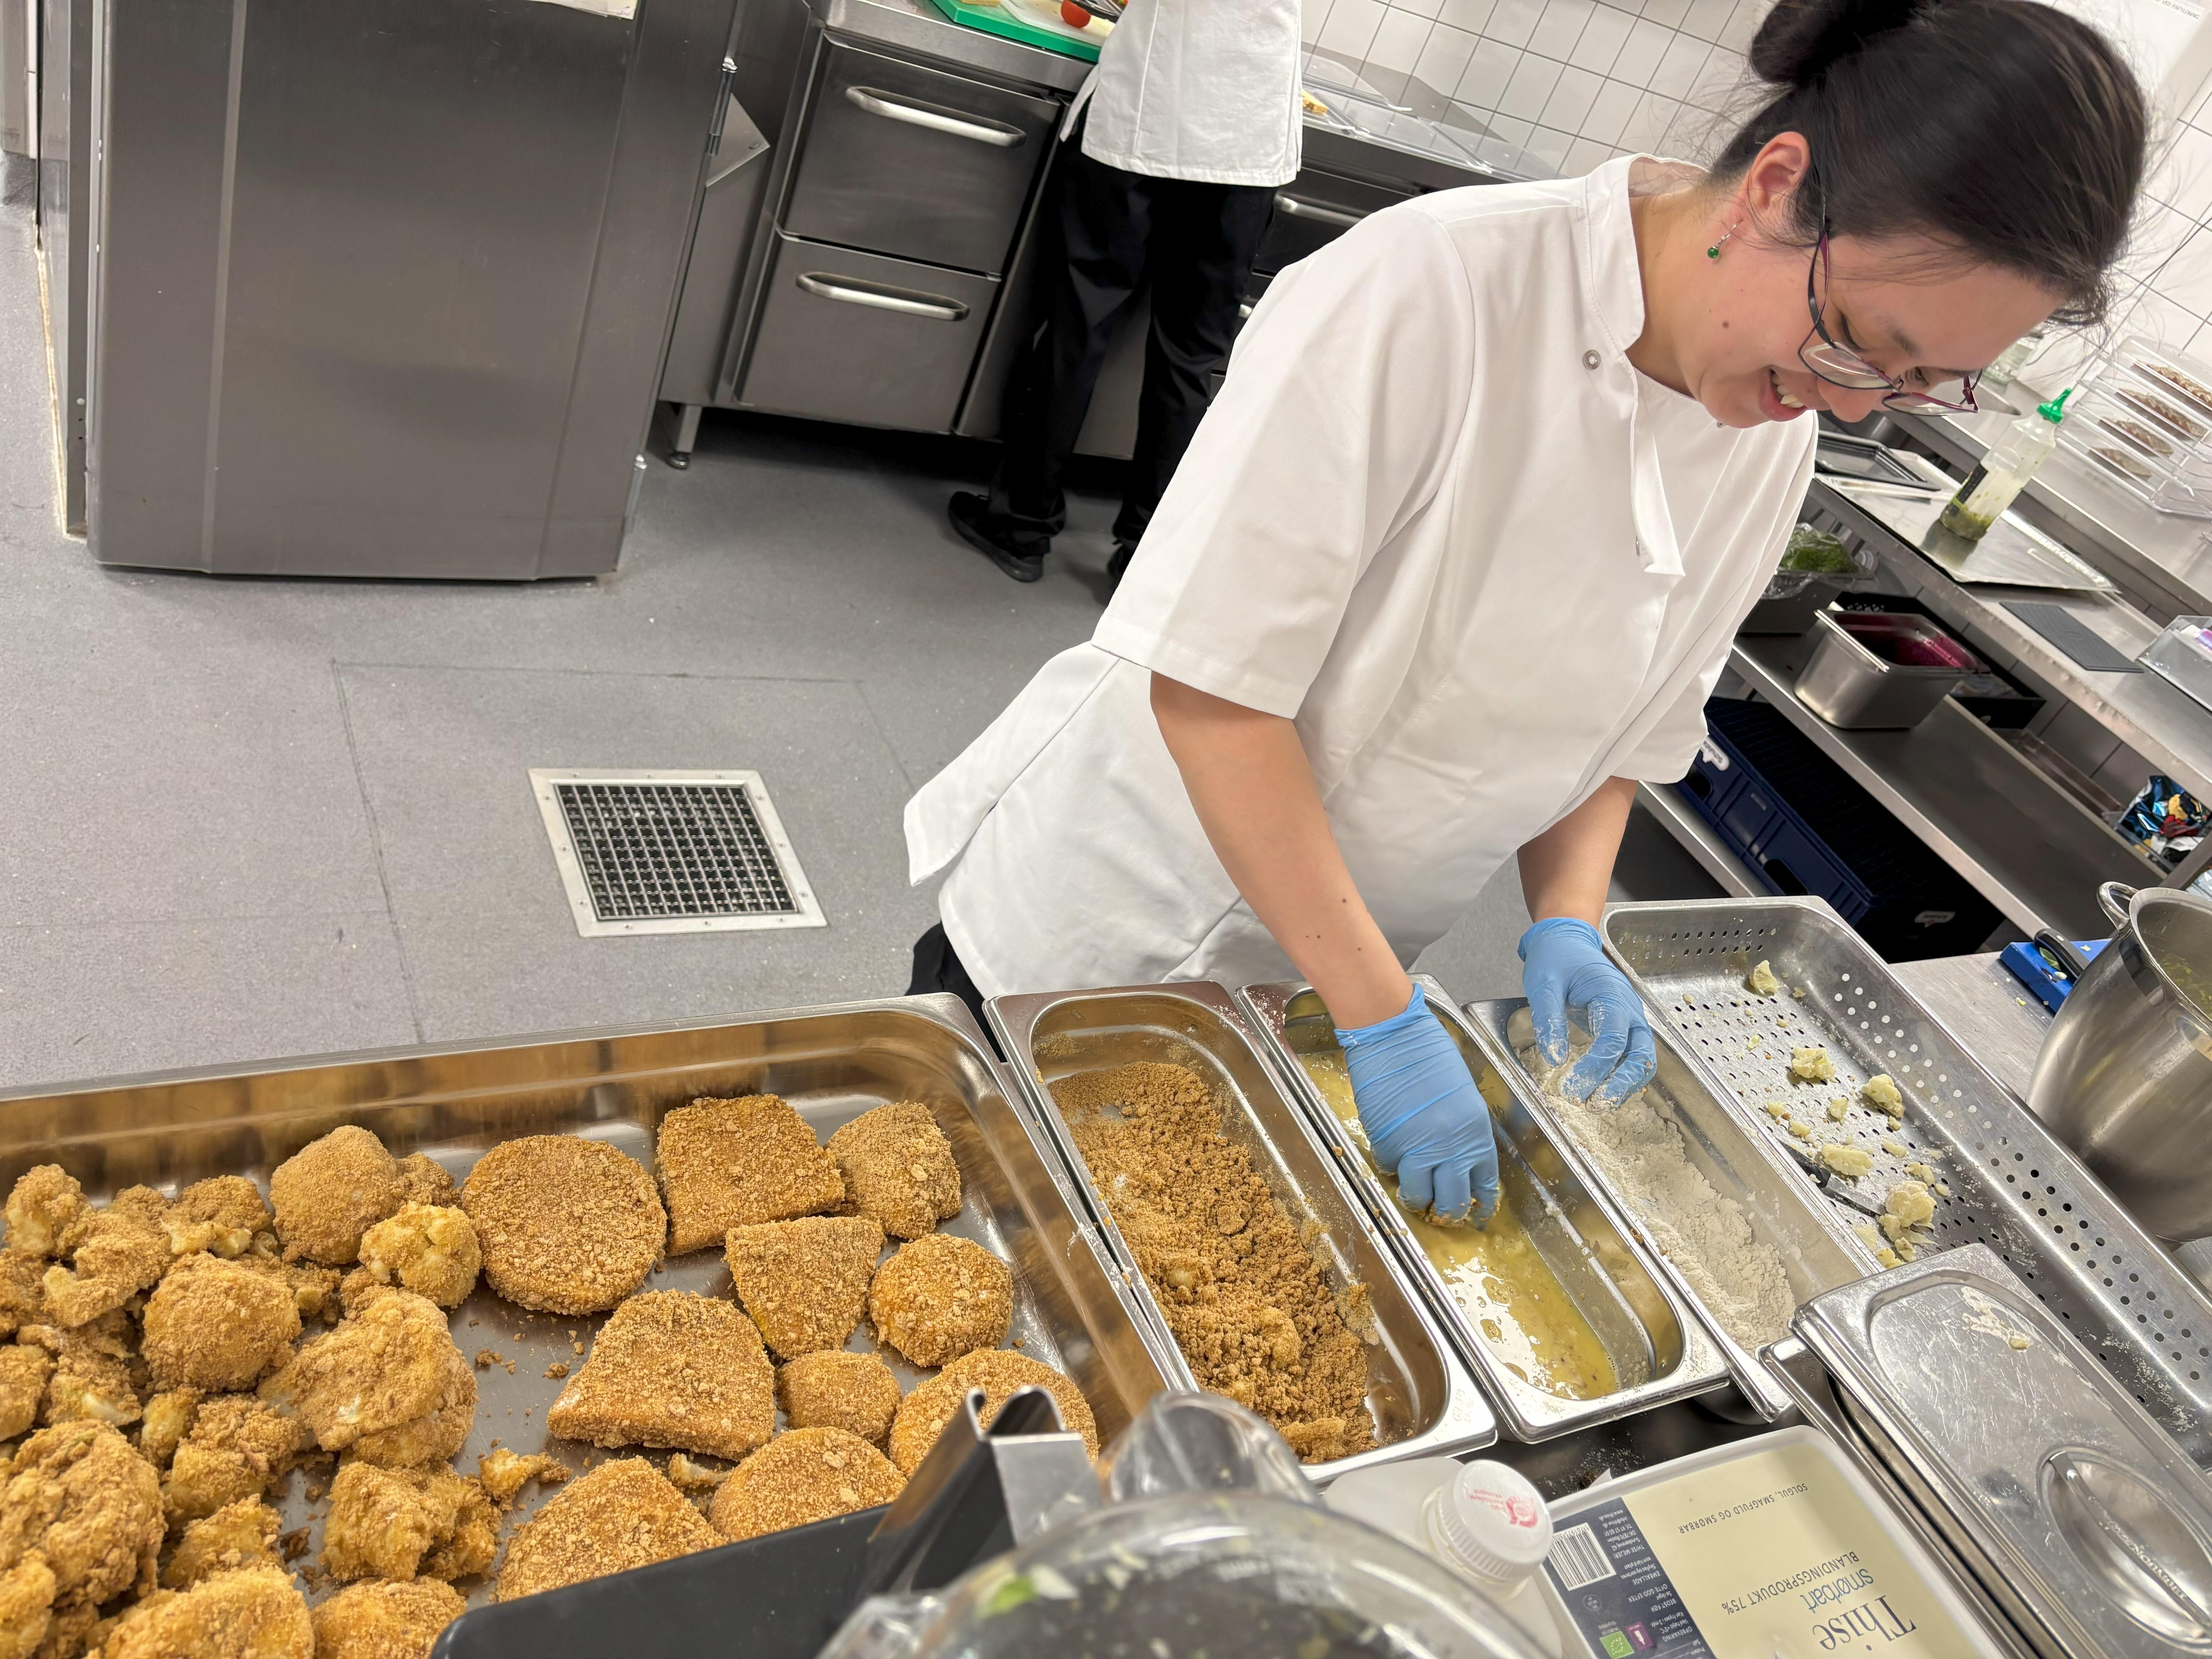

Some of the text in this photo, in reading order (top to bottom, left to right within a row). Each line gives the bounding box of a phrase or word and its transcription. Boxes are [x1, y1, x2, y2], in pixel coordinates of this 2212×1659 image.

[1678, 1483, 1808, 1534] SOLGUL, SMAGFULD OG SMØRBAR
[1613, 1544, 1644, 1558] THISE MEJERI
[1632, 1571, 1660, 1584] EMBALLAGE
[1721, 1551, 1859, 1614] BLANDINGSPRODUKT 75%
[1654, 1584, 1667, 1592] OFTE
[1800, 1568, 1874, 1613] smørbart
[1628, 1593, 1643, 1602] EFTER
[1662, 1598, 1676, 1608] BEDST
[1812, 1595, 1917, 1651] Thise
[1662, 1626, 1692, 1642] OPBEVARING
